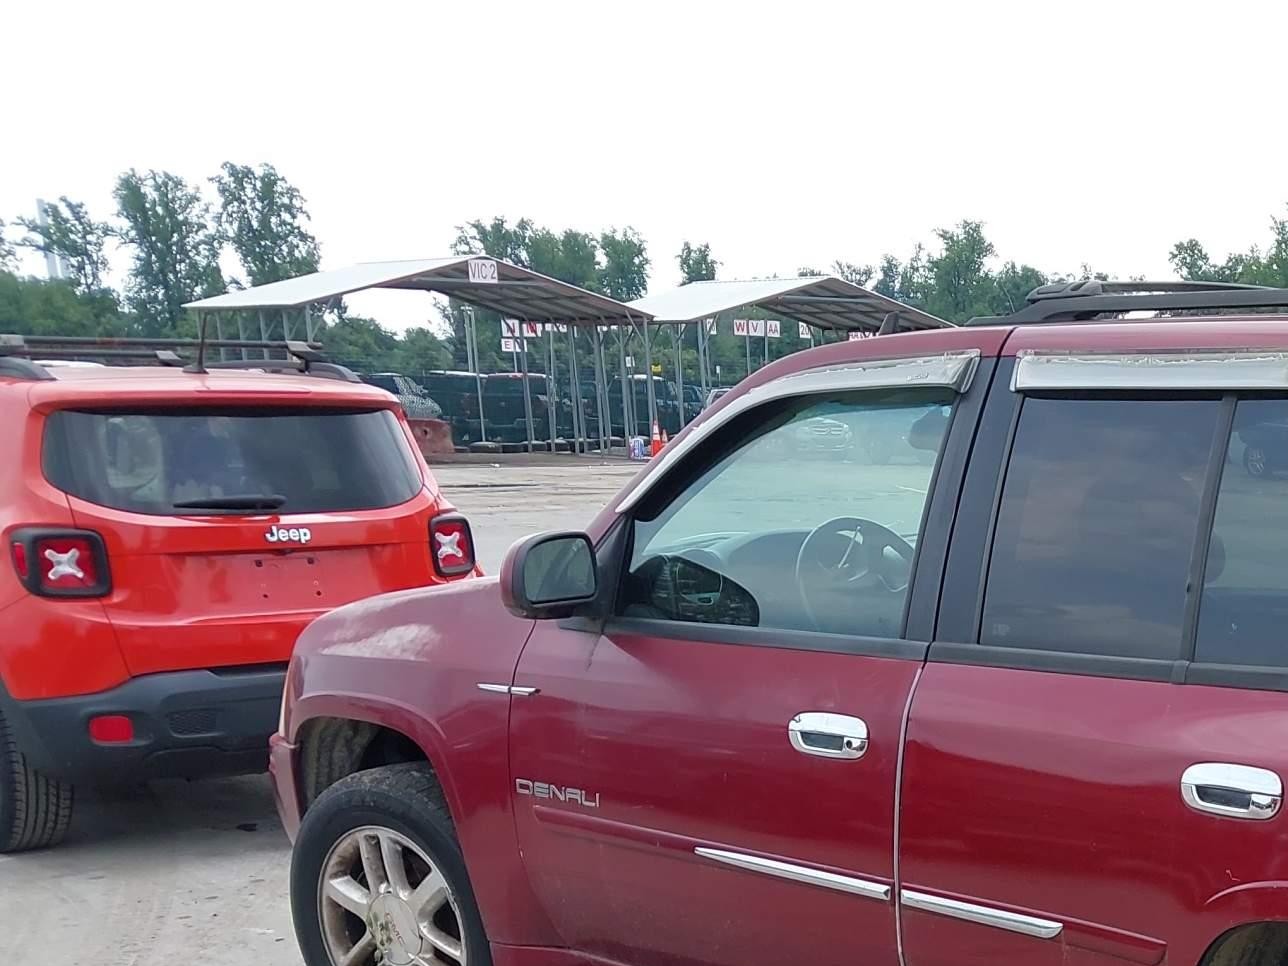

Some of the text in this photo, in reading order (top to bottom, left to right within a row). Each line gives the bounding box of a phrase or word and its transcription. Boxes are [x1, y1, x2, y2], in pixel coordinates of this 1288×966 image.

[469, 263, 497, 279] VIC 2
[735, 321, 746, 332] W
[265, 526, 311, 543] Jeep
[515, 778, 600, 807] DENALI
